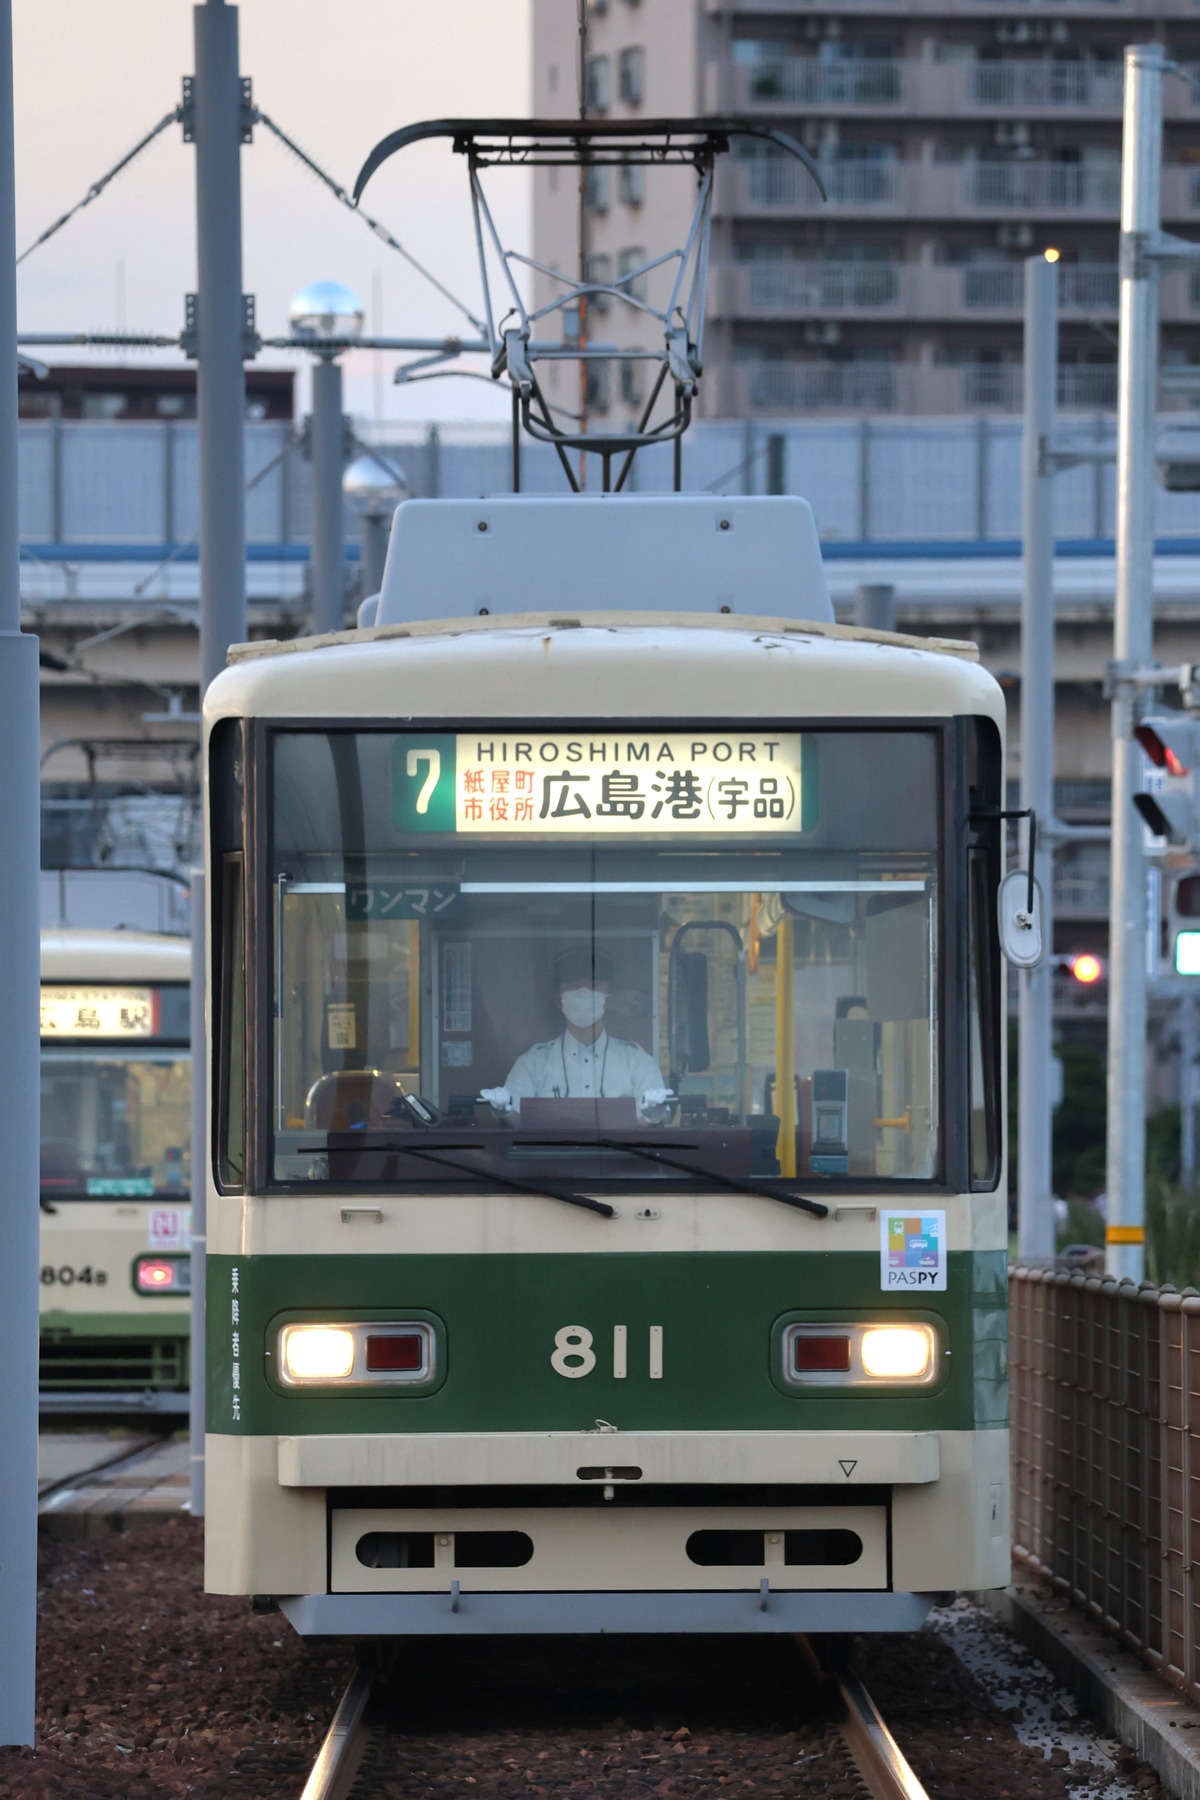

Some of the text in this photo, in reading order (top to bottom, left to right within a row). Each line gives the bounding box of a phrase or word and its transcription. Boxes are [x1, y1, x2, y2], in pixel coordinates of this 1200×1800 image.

[477, 742, 780, 762] HIROSHIMA PORT
[406, 749, 441, 815] 7
[463, 769, 535, 794] 紙屋町
[463, 797, 535, 821] 市役所
[351, 889, 456, 913] ワンマン
[888, 1271, 939, 1285] PASPY
[550, 1325, 664, 1379] 811
